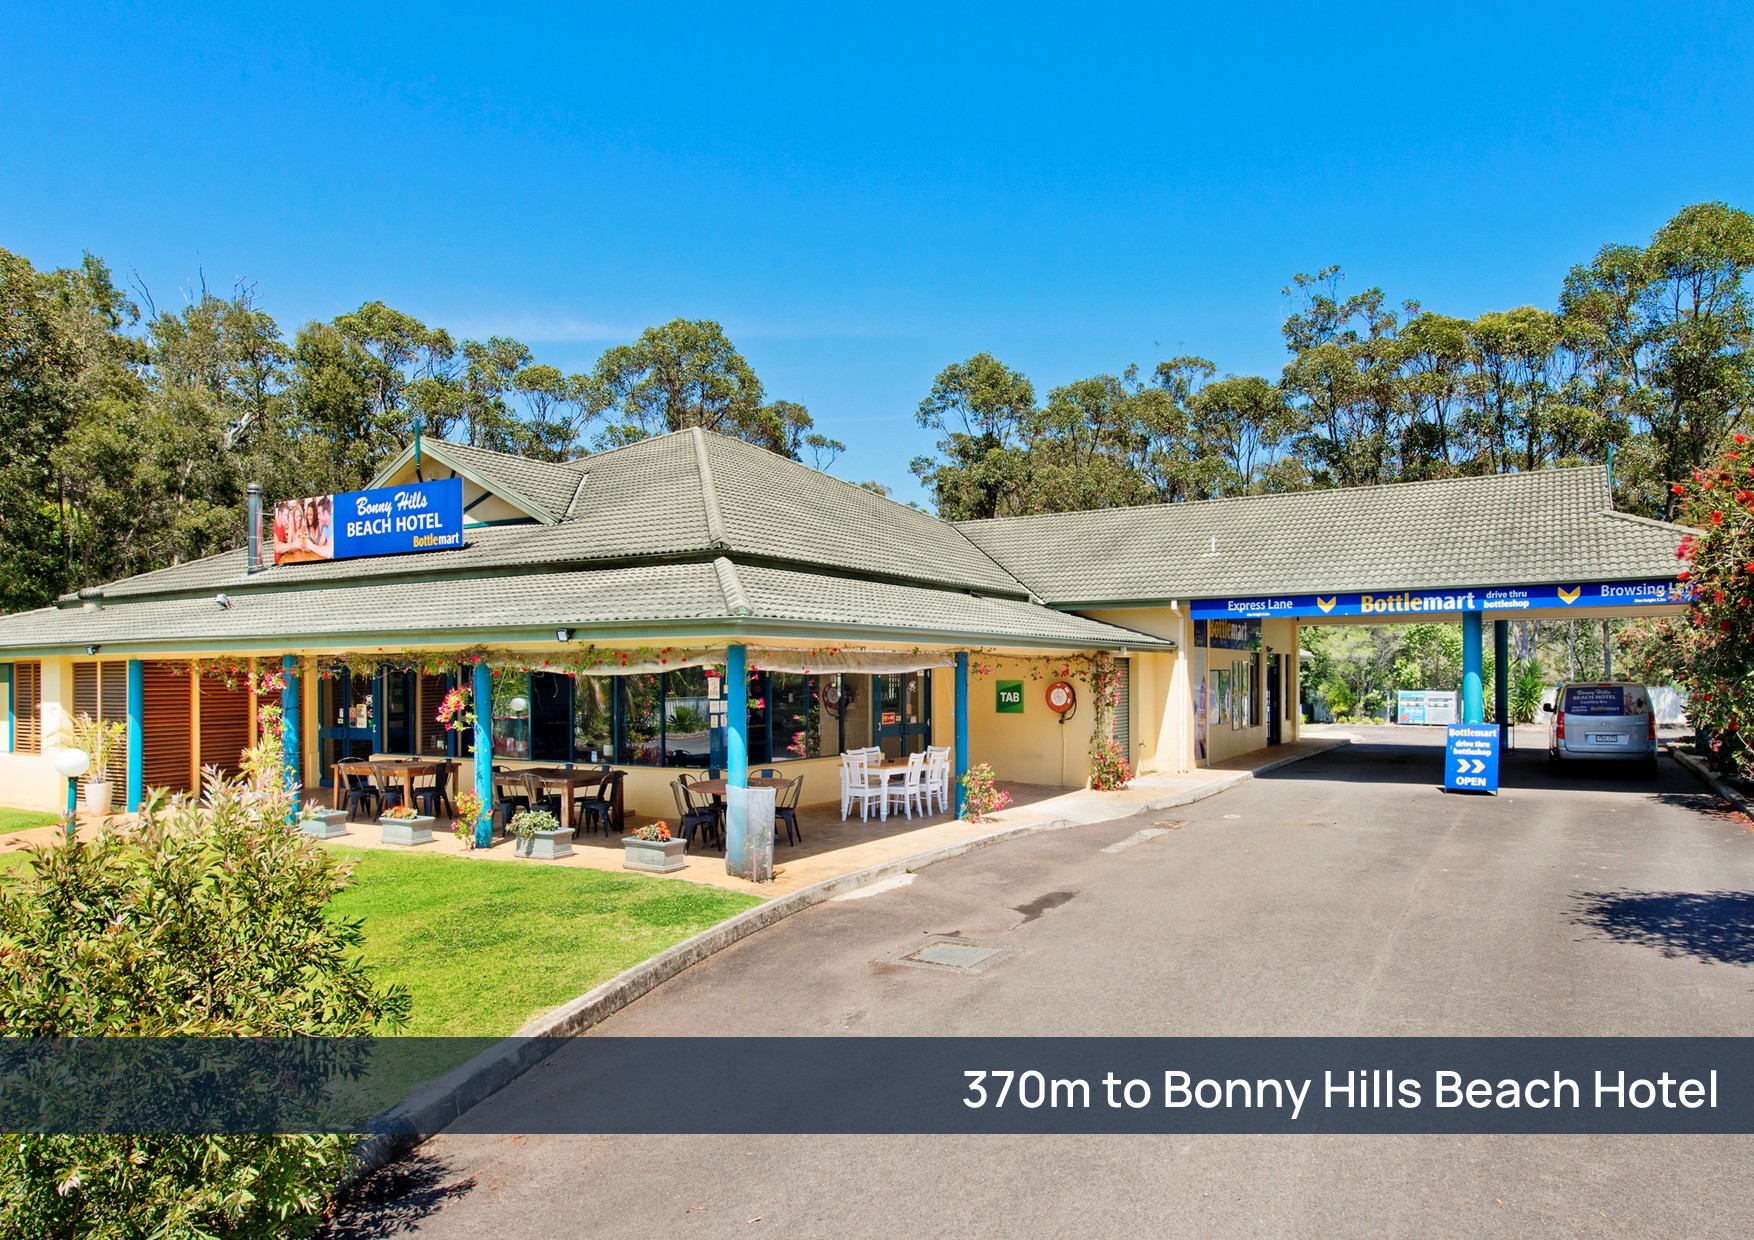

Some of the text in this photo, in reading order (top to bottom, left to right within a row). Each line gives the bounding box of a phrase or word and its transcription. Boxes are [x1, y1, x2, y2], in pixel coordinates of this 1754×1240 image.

[356, 491, 428, 518] Bonny Hills
[347, 512, 443, 538] BEACH HOTEL
[413, 532, 460, 548] Bottlemart
[1486, 590, 1528, 599] drive thru
[1601, 583, 1665, 598] Browsing
[1228, 599, 1293, 613] Express Lane
[1361, 592, 1476, 613] Bottlemart
[1483, 599, 1530, 609] bottleshop
[1209, 619, 1248, 641] Bottlemart
[1000, 692, 1020, 702] TAB
[1449, 728, 1497, 738] Bottlemart
[1455, 740, 1474, 748] drive
[1453, 748, 1492, 757] bottleshop
[1455, 776, 1487, 787] OPEN
